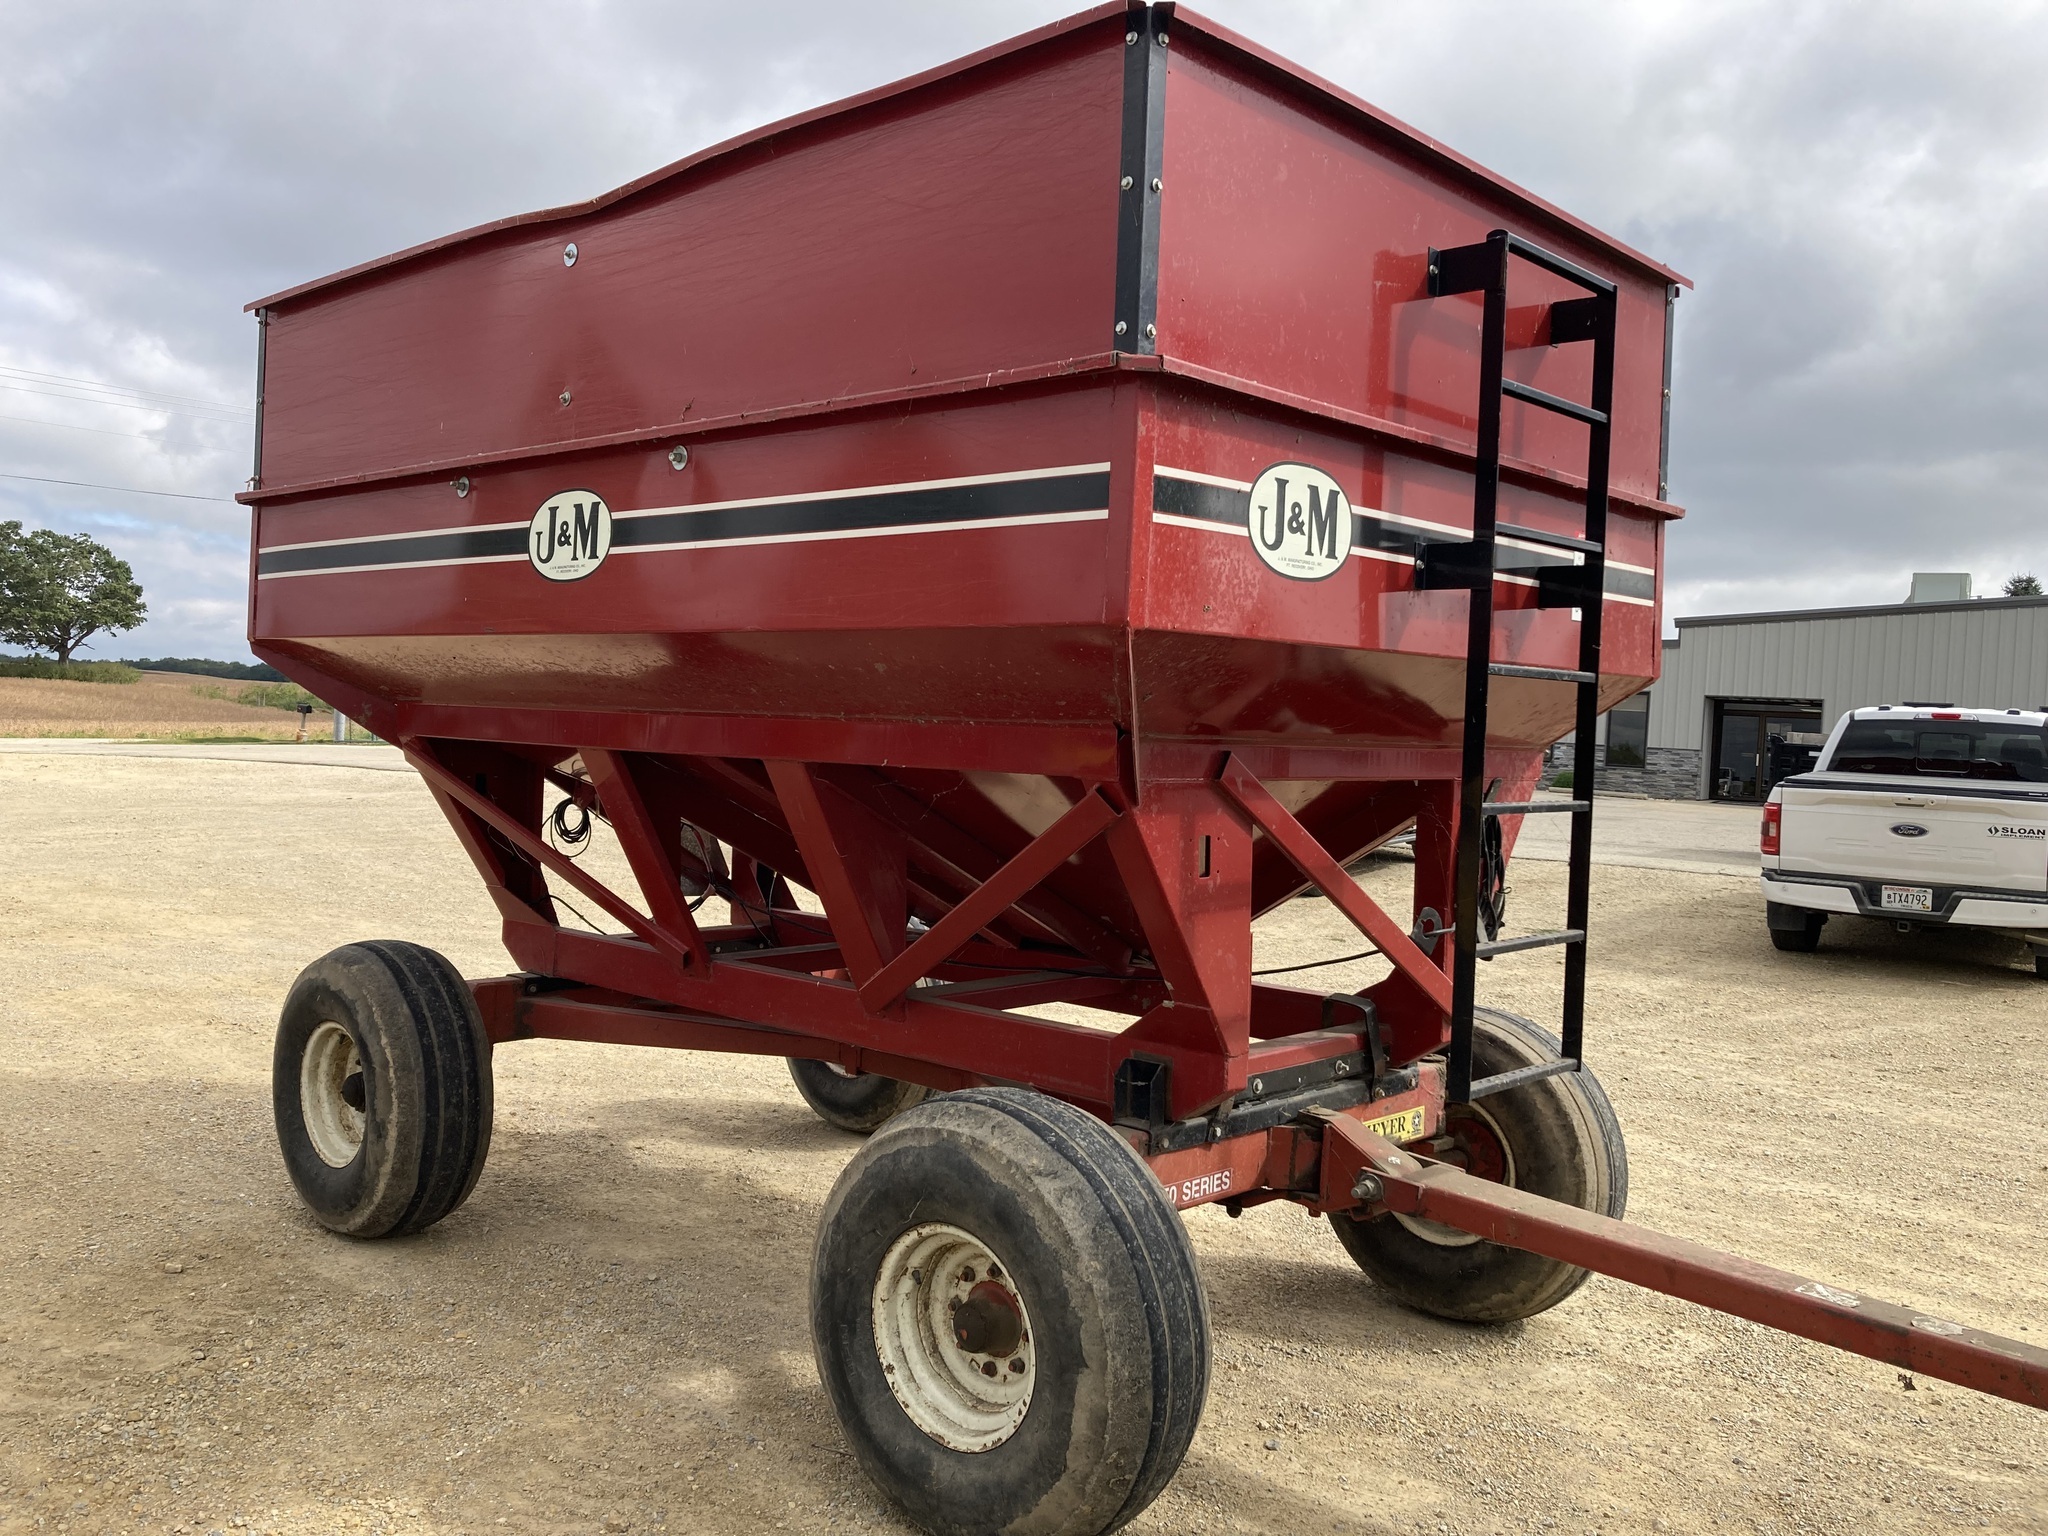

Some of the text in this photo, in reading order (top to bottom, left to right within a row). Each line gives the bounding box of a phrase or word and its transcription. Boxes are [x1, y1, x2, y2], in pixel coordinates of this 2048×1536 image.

[1258, 477, 1340, 560] J&M
[535, 501, 602, 564] J&M
[1898, 825, 1920, 835] Ford
[2001, 826, 2046, 836] SLOAN
[1892, 892, 1928, 906] TX4792
[1182, 1171, 1230, 1201] SERIES
